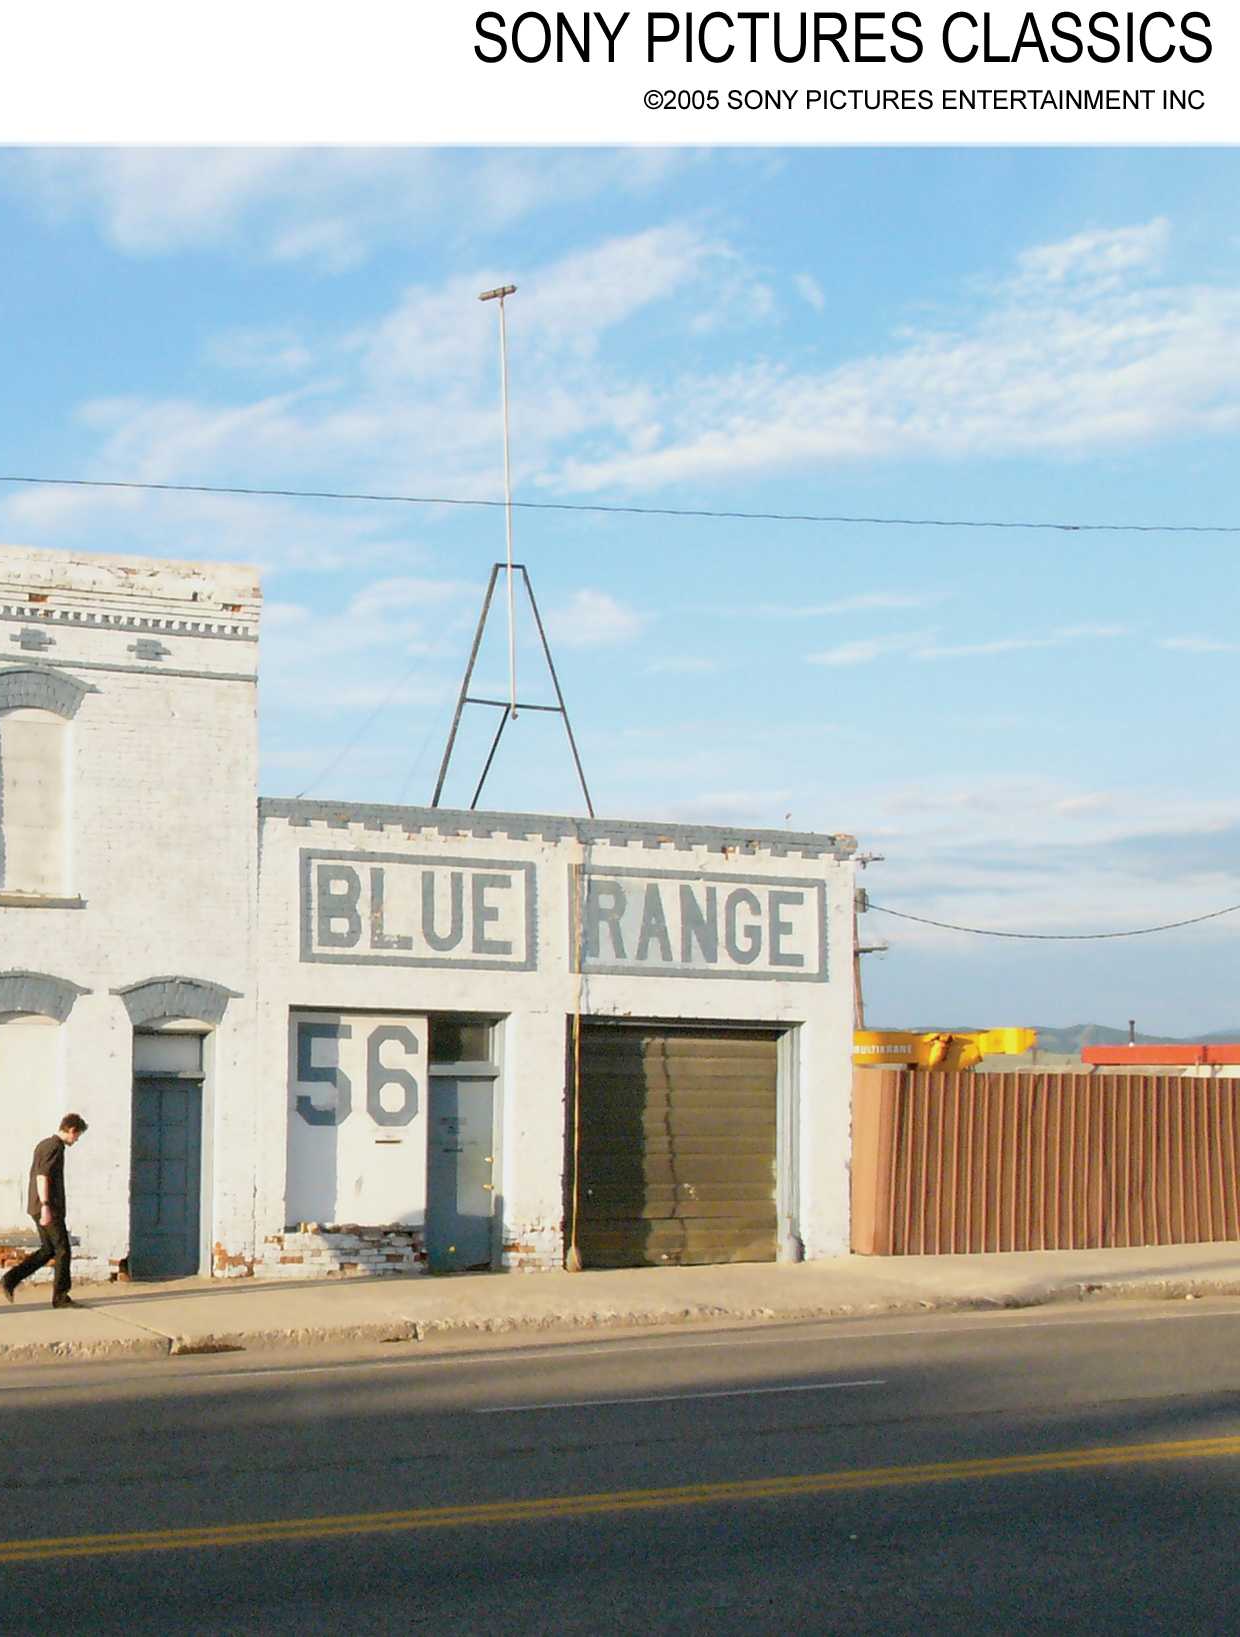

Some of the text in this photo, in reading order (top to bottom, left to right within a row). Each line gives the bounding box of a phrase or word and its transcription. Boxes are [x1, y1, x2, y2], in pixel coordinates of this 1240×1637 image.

[317, 864, 804, 966] BLUE RANGE
[296, 1022, 418, 1126] 56
